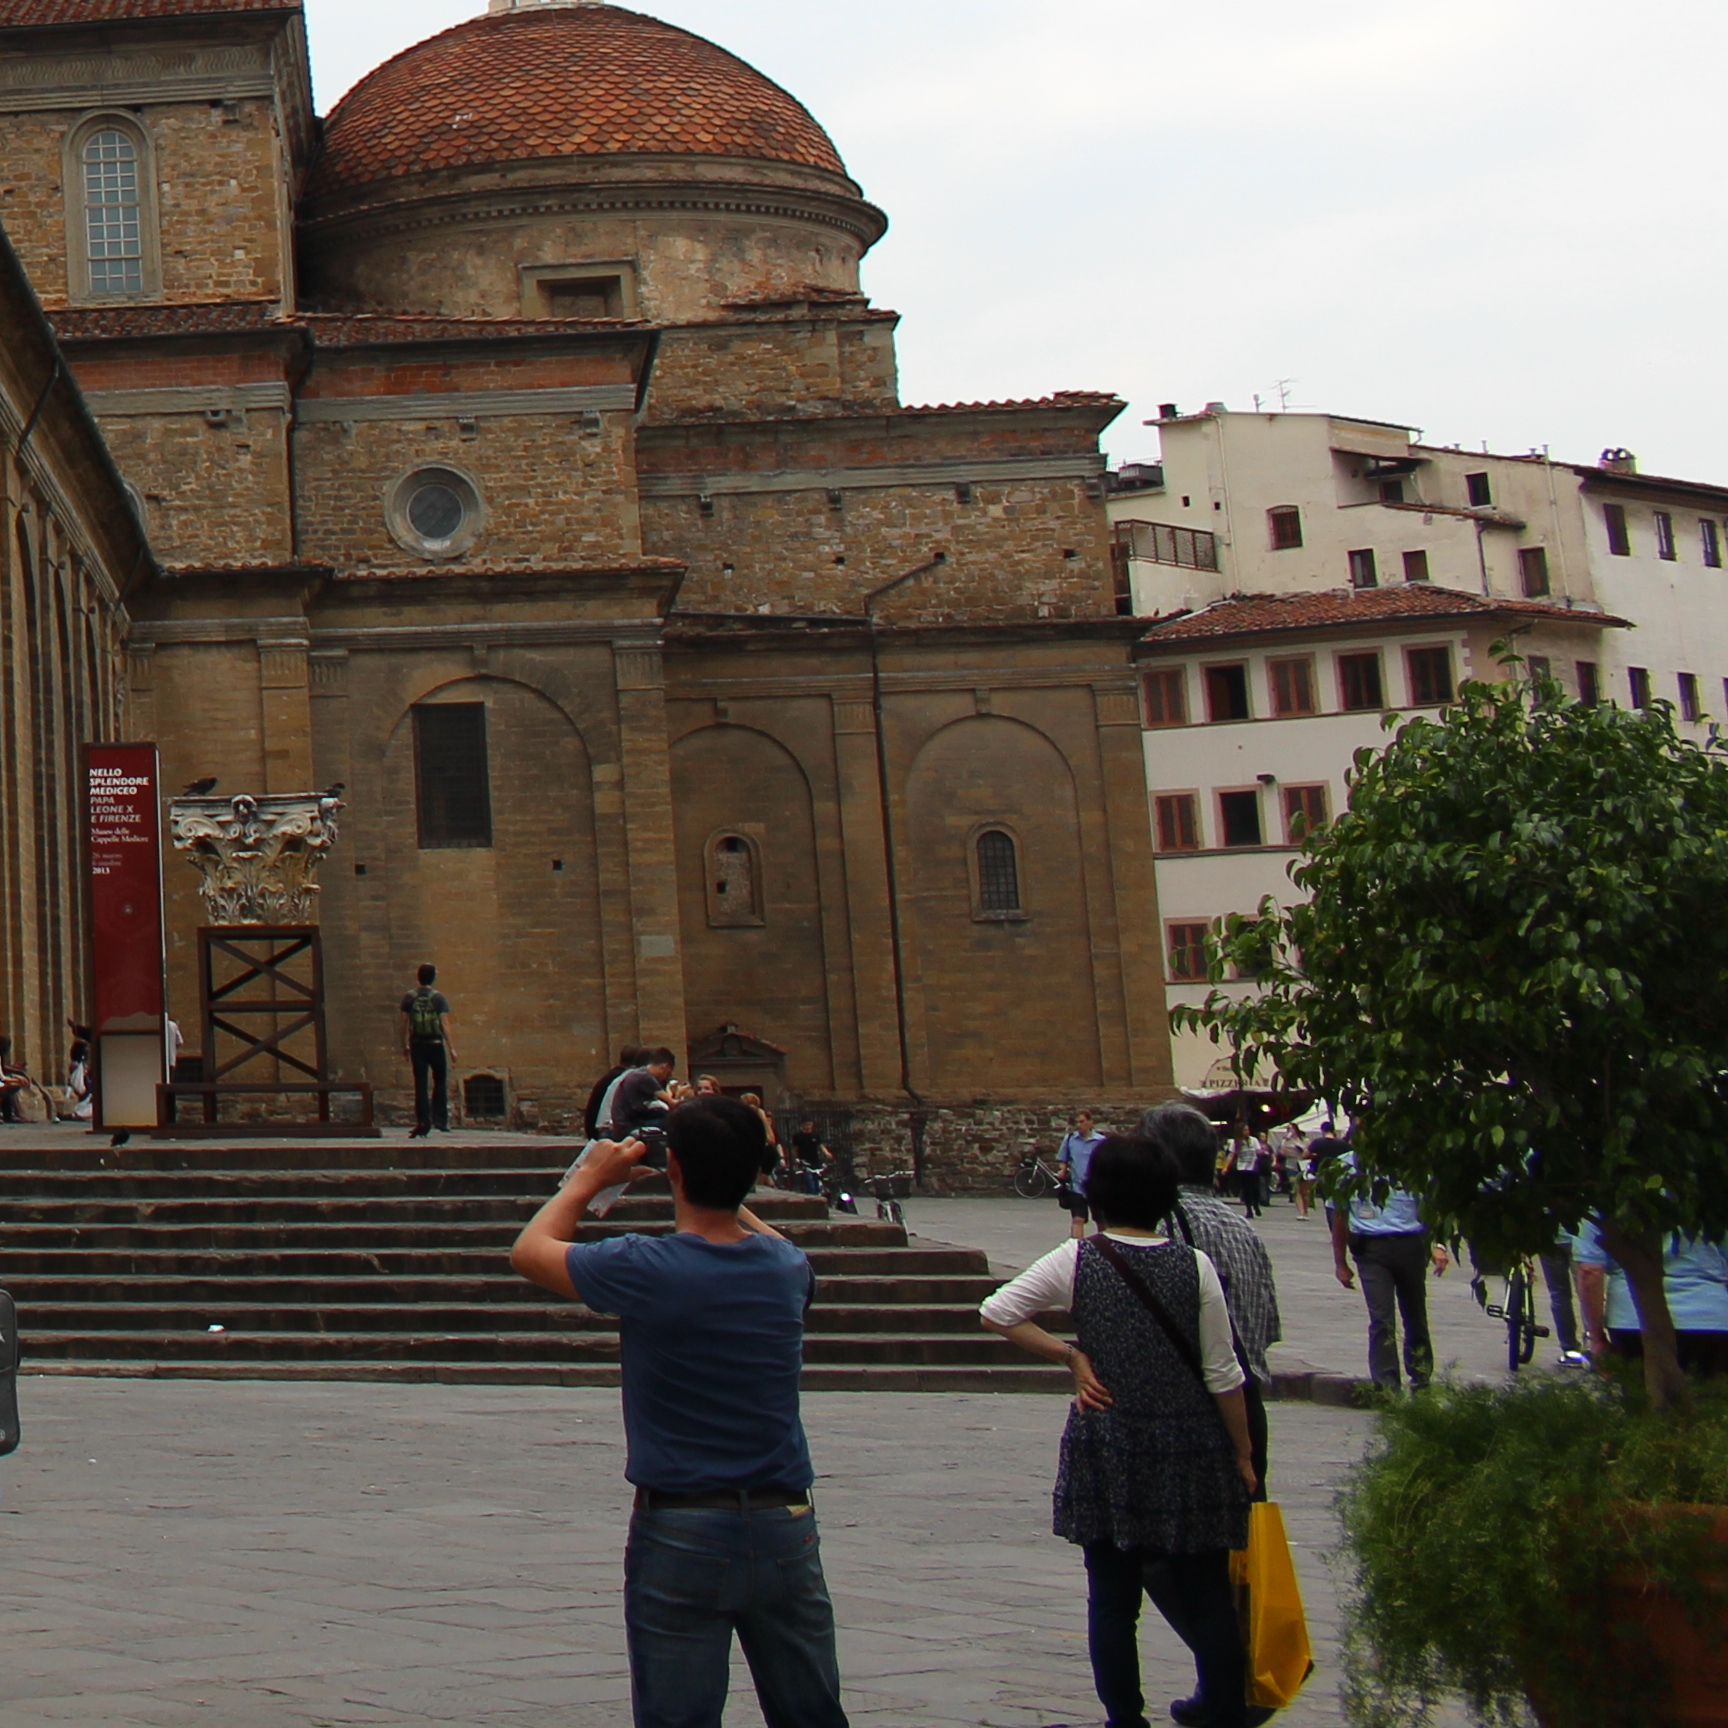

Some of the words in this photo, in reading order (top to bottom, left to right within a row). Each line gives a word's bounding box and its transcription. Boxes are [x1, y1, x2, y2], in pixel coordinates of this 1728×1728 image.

[89, 768, 123, 777] NELLO
[89, 777, 149, 786] SPLENDORE
[89, 786, 138, 795] MEDICEO
[90, 796, 115, 804] PAPA
[90, 805, 125, 814] LEONE
[126, 805, 134, 813] X
[91, 815, 97, 823] E
[99, 814, 142, 823] FIRENZE
[91, 827, 113, 835] Museo
[114, 827, 130, 835] delle
[91, 835, 120, 845] Cappelle
[92, 867, 111, 875] 2013
